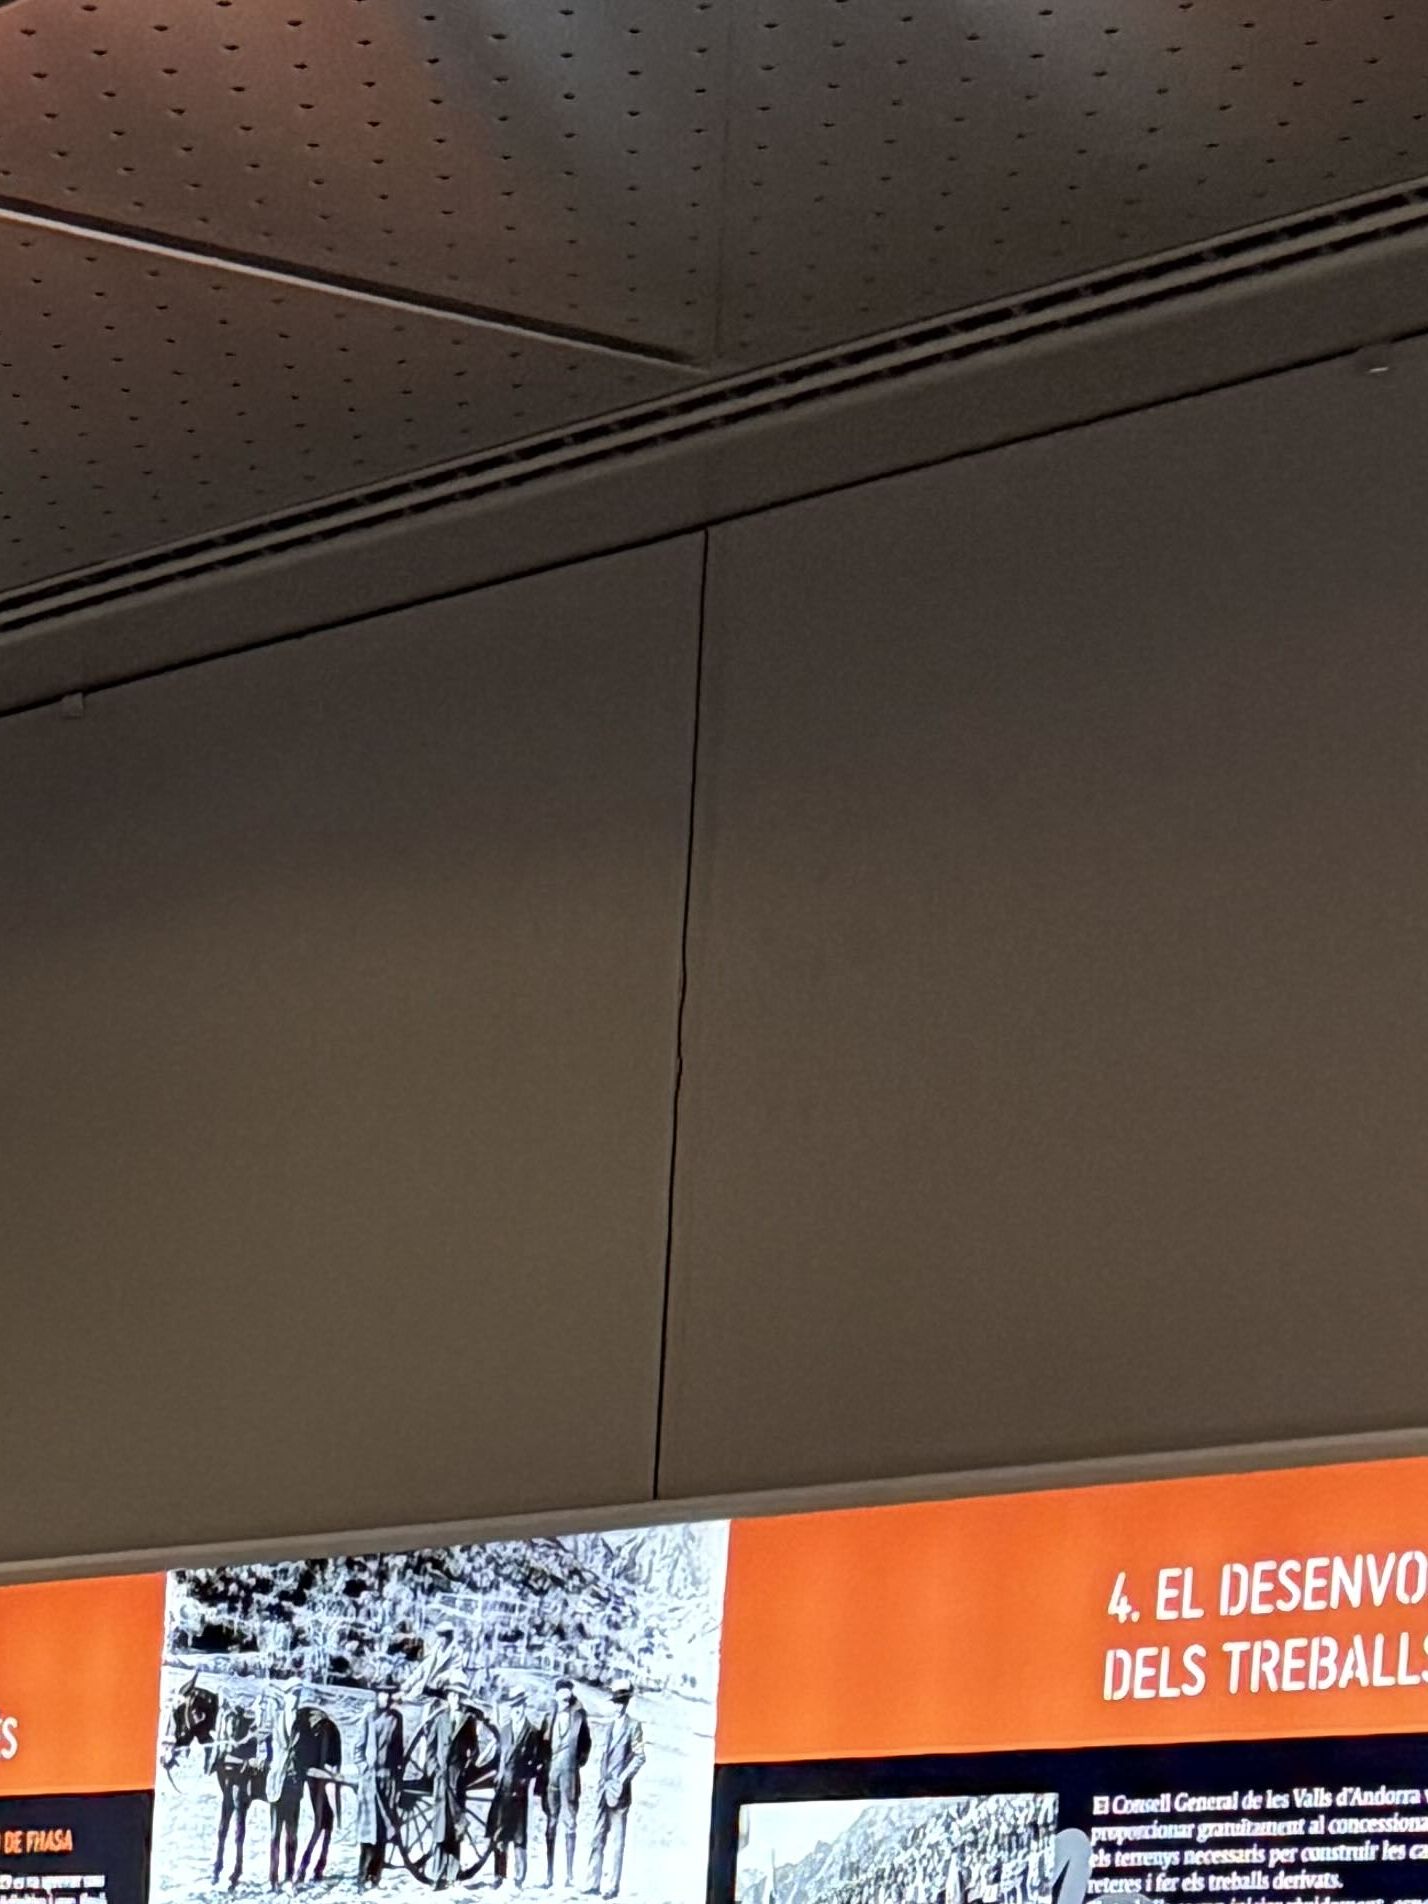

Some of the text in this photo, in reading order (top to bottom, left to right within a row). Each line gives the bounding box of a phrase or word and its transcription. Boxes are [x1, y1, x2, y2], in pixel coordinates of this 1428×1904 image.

[1107, 1571, 1140, 1624] 4.
[1156, 1566, 1204, 1620] EL
[1103, 1643, 1207, 1700] DELS
[1093, 1796, 1109, 1815] El
